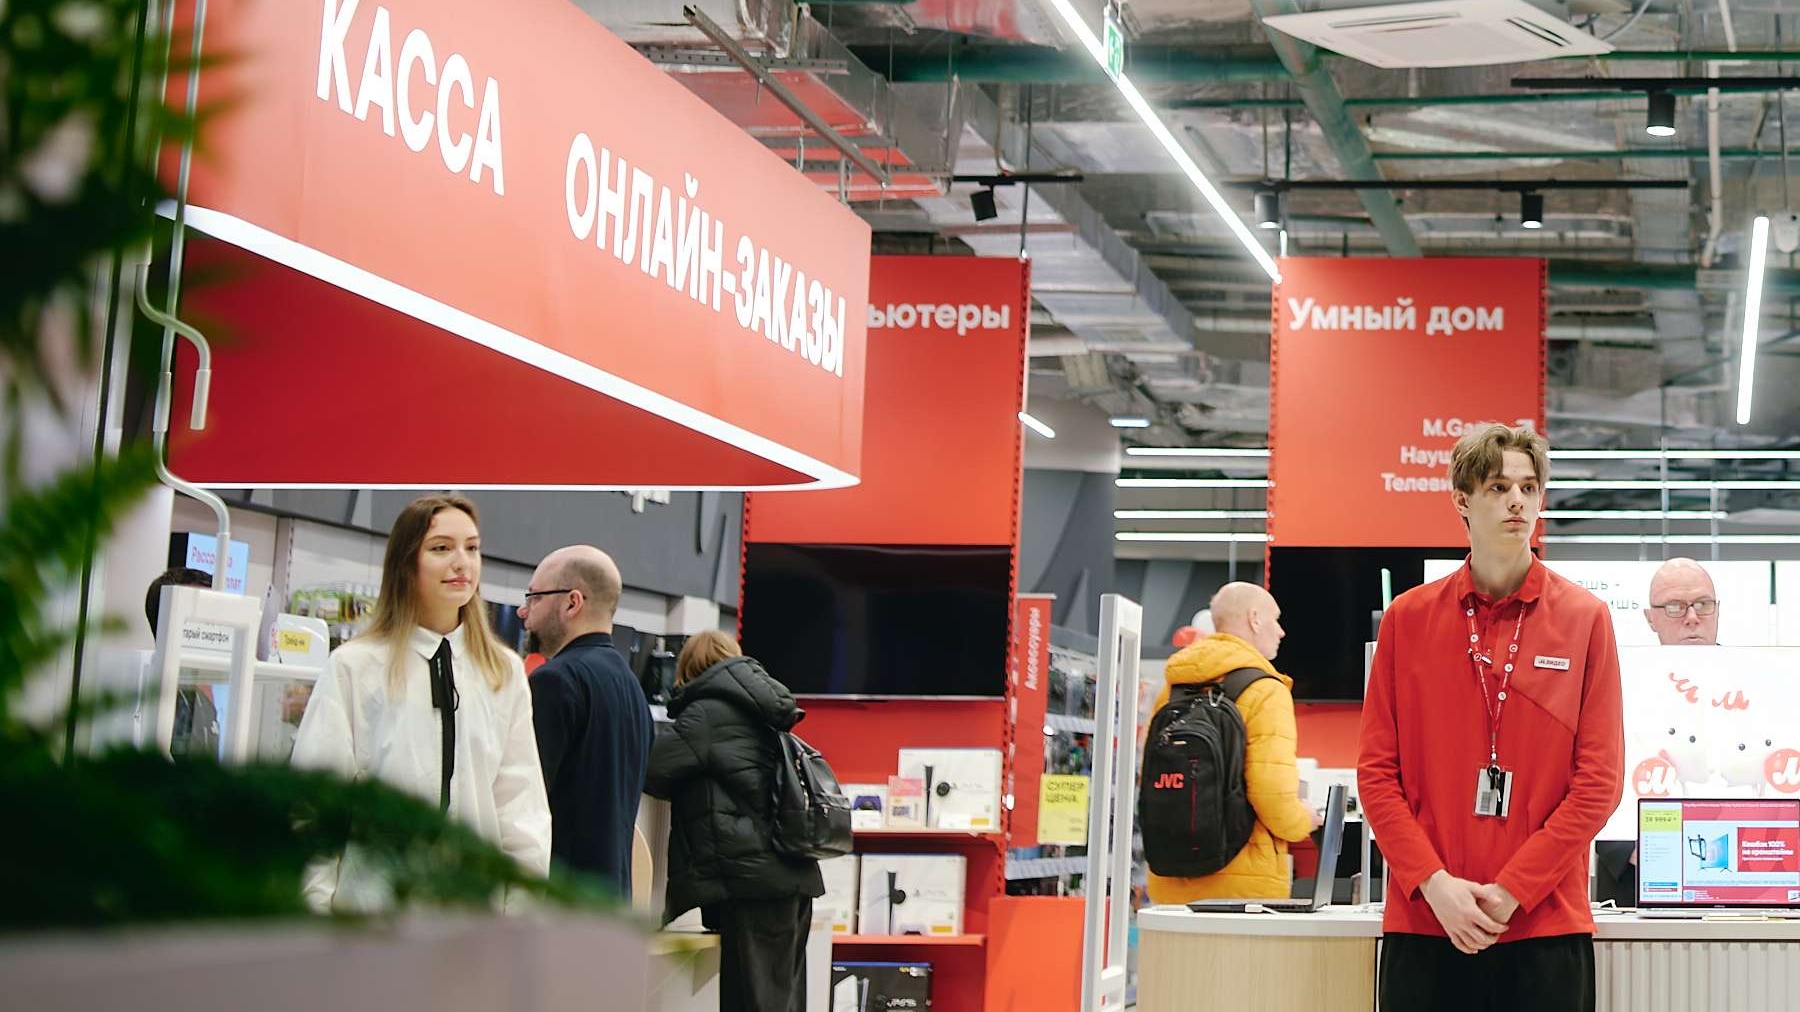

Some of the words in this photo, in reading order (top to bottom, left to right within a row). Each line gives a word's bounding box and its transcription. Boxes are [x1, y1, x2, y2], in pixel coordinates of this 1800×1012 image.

[564, 131, 847, 379] ОНЛАЙН-ЗАКАЗЫ
[1287, 296, 1417, 332] Умный
[1425, 305, 1504, 336] дом
[1153, 772, 1185, 790] JVC
